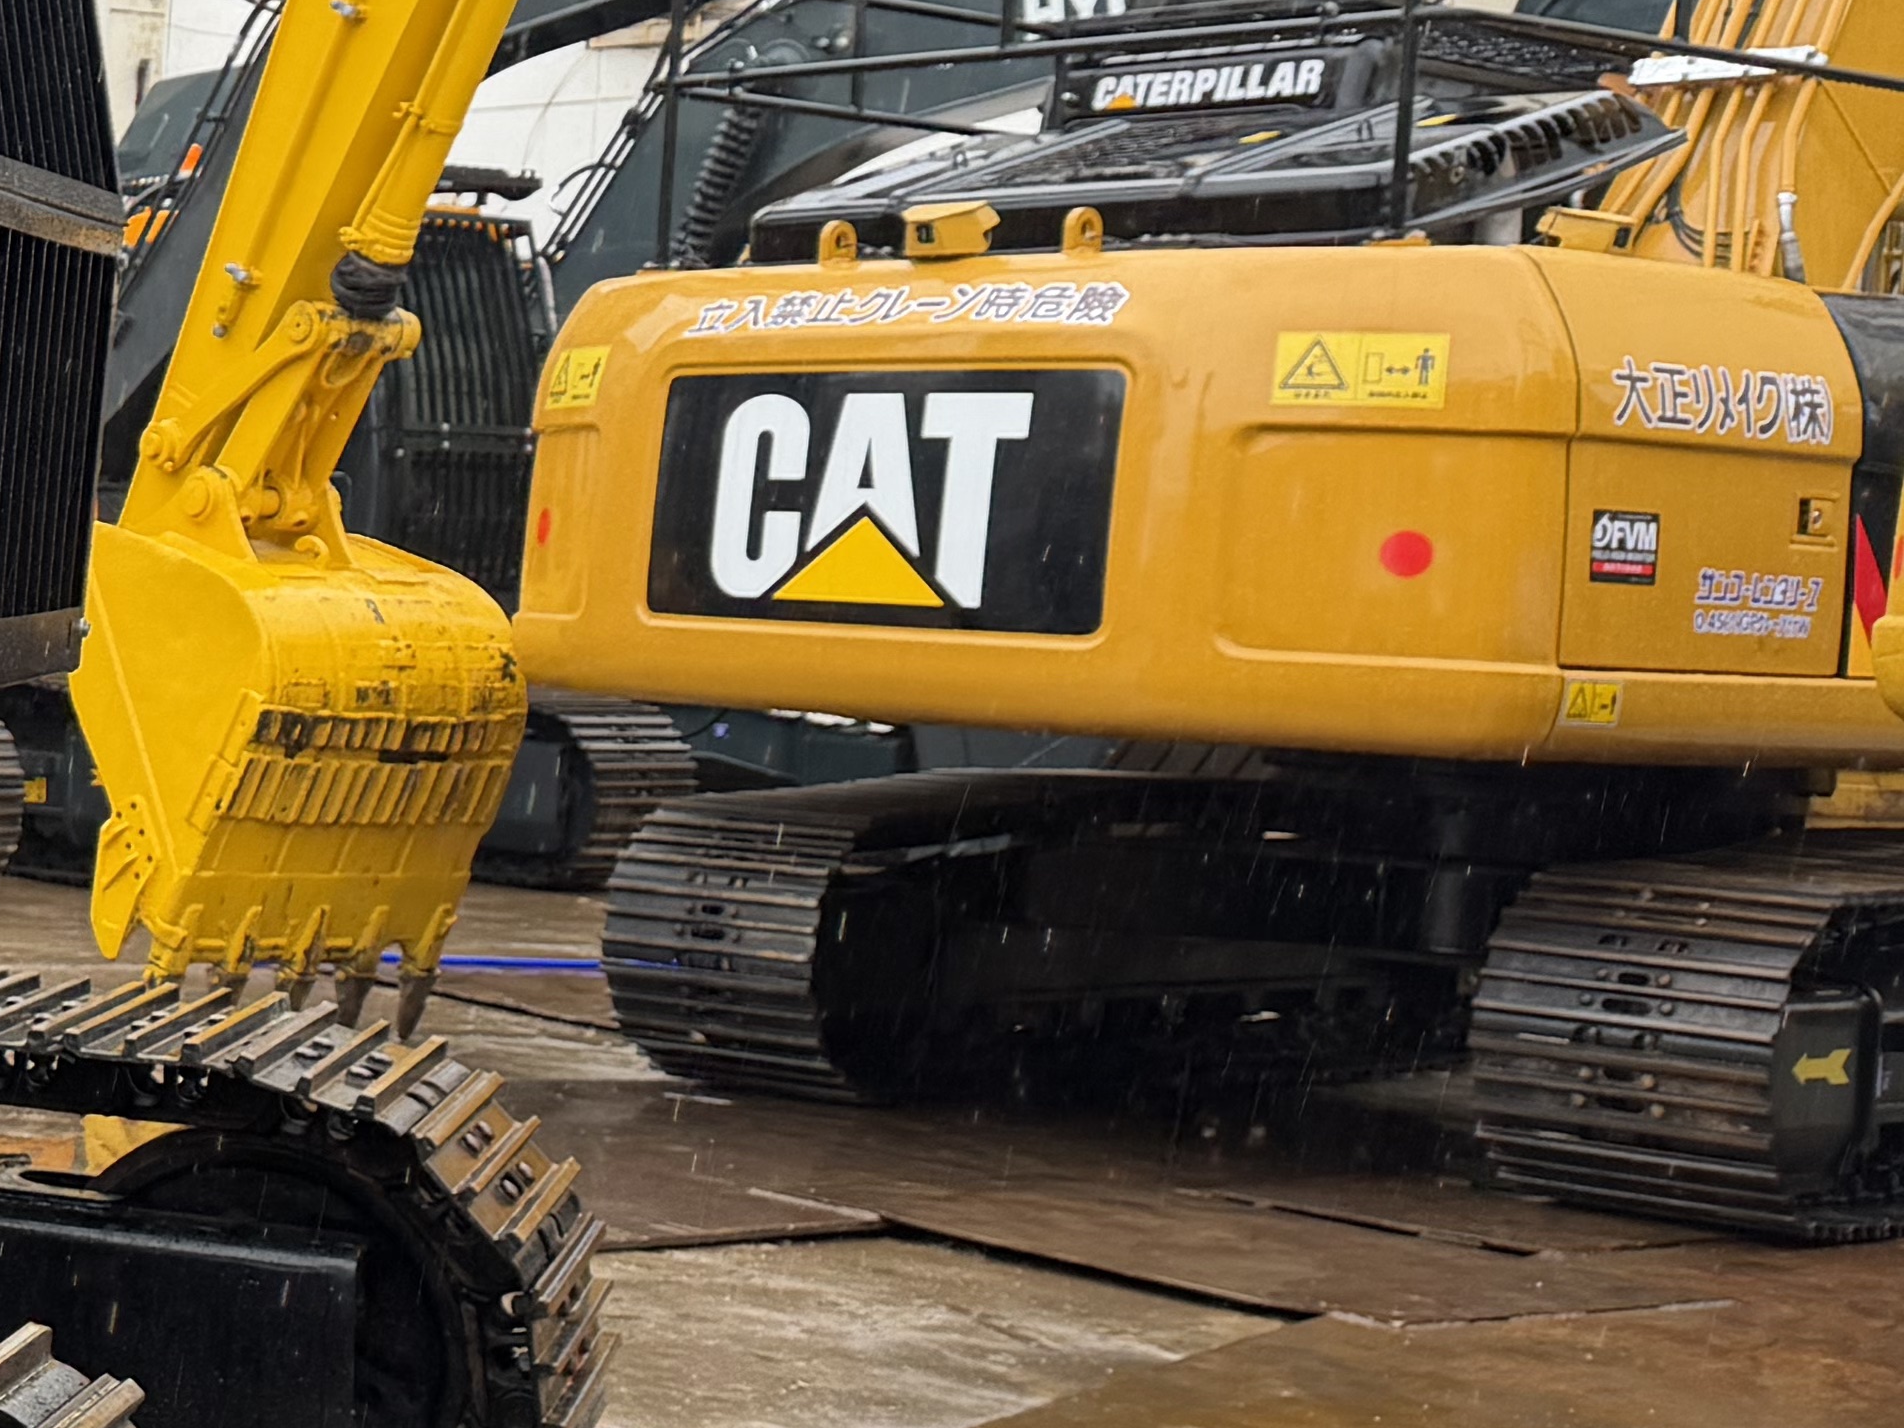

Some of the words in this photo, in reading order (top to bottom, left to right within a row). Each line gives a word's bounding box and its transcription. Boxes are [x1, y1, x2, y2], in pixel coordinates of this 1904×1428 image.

[1093, 58, 1325, 112] CATERPILLAR
[1613, 356, 1833, 442] 大正リメイク(株)
[709, 392, 1034, 609] CAT
